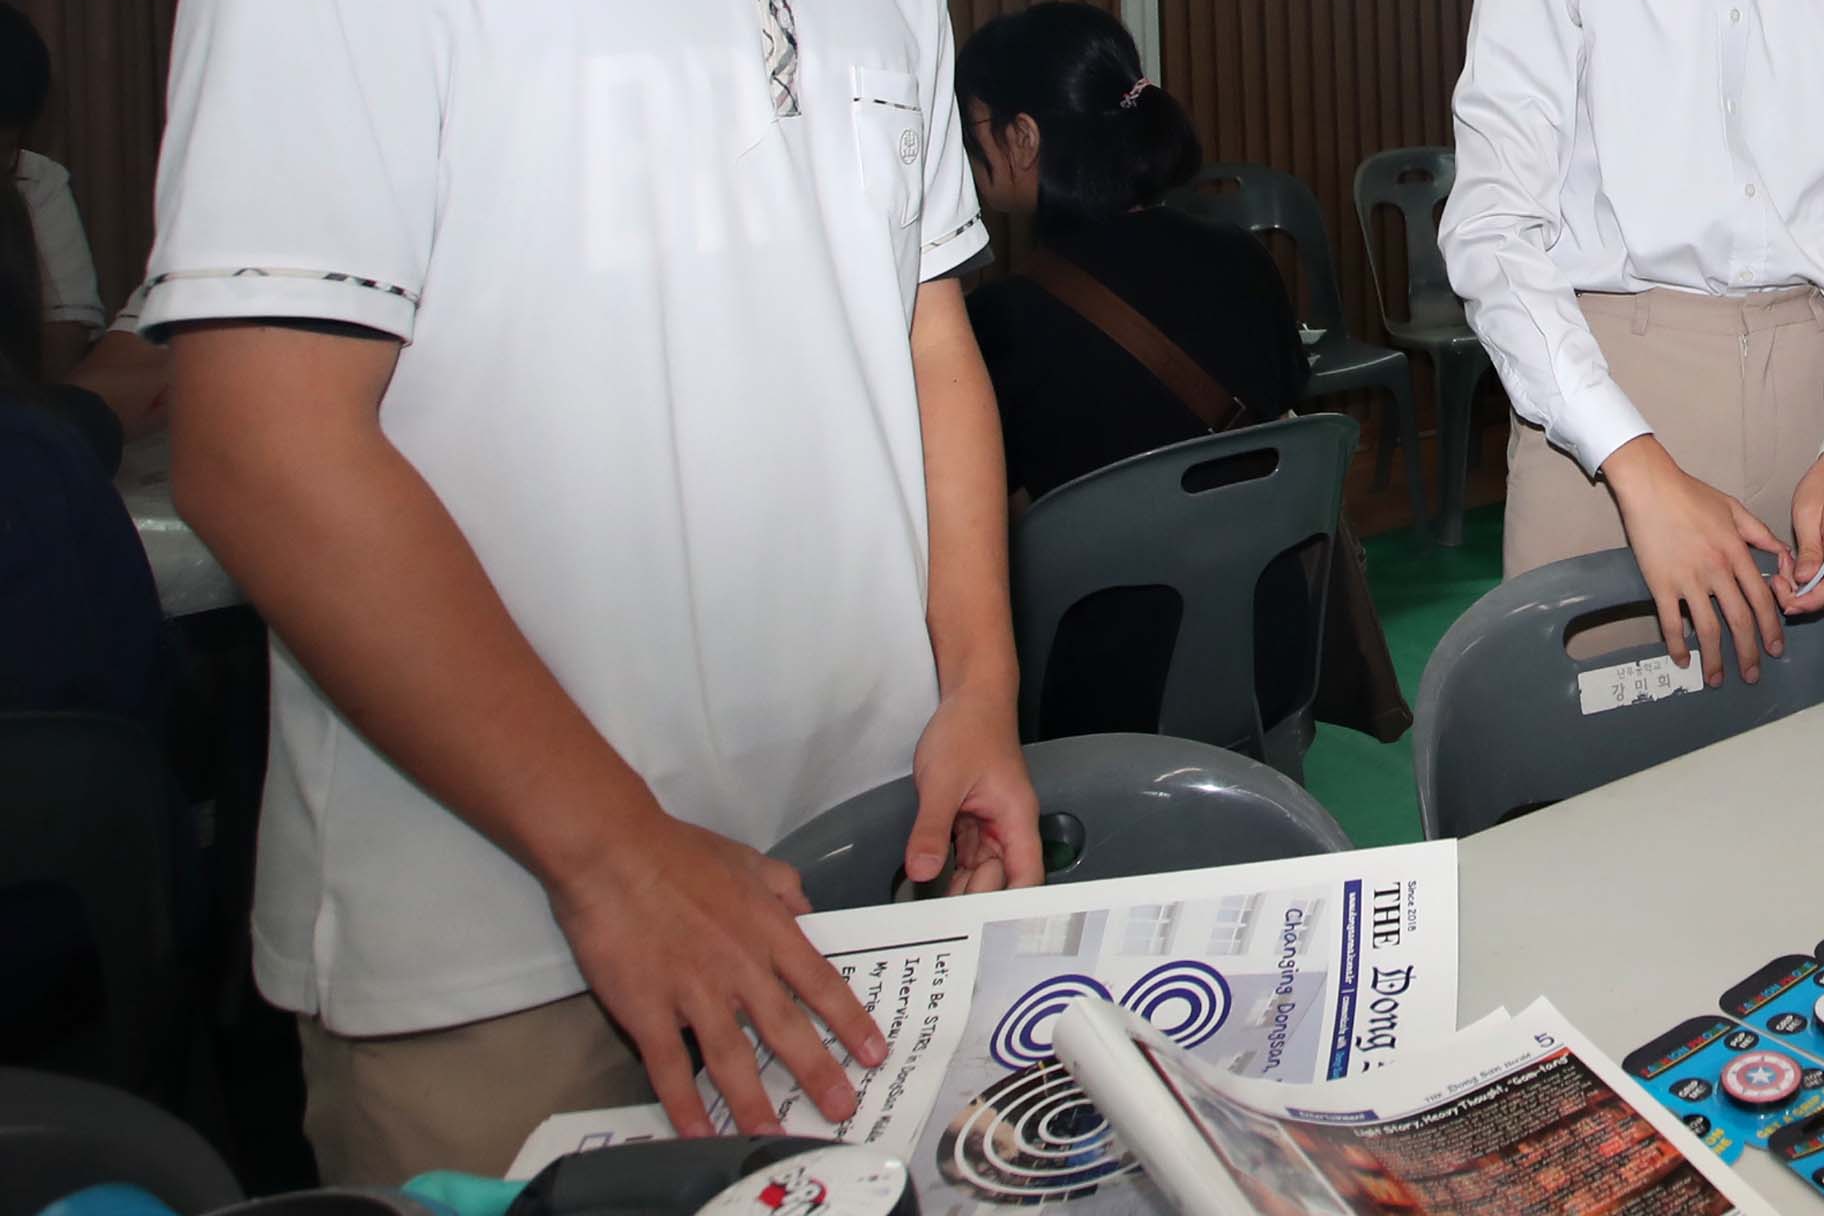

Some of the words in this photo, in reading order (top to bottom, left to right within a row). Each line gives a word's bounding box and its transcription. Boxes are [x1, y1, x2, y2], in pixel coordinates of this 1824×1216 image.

[1407, 879, 1417, 907] Since
[1371, 881, 1402, 950] THE
[1407, 908, 1417, 933] 2018
[1273, 907, 1304, 993] Changing
[868, 960, 888, 979] My
[932, 953, 951, 987] Let's
[887, 957, 920, 1040] Interview
[927, 992, 945, 1010] Be
[1355, 964, 1416, 1053] Dong
[912, 1015, 939, 1053] STARS
[1532, 1032, 1556, 1048] 5
